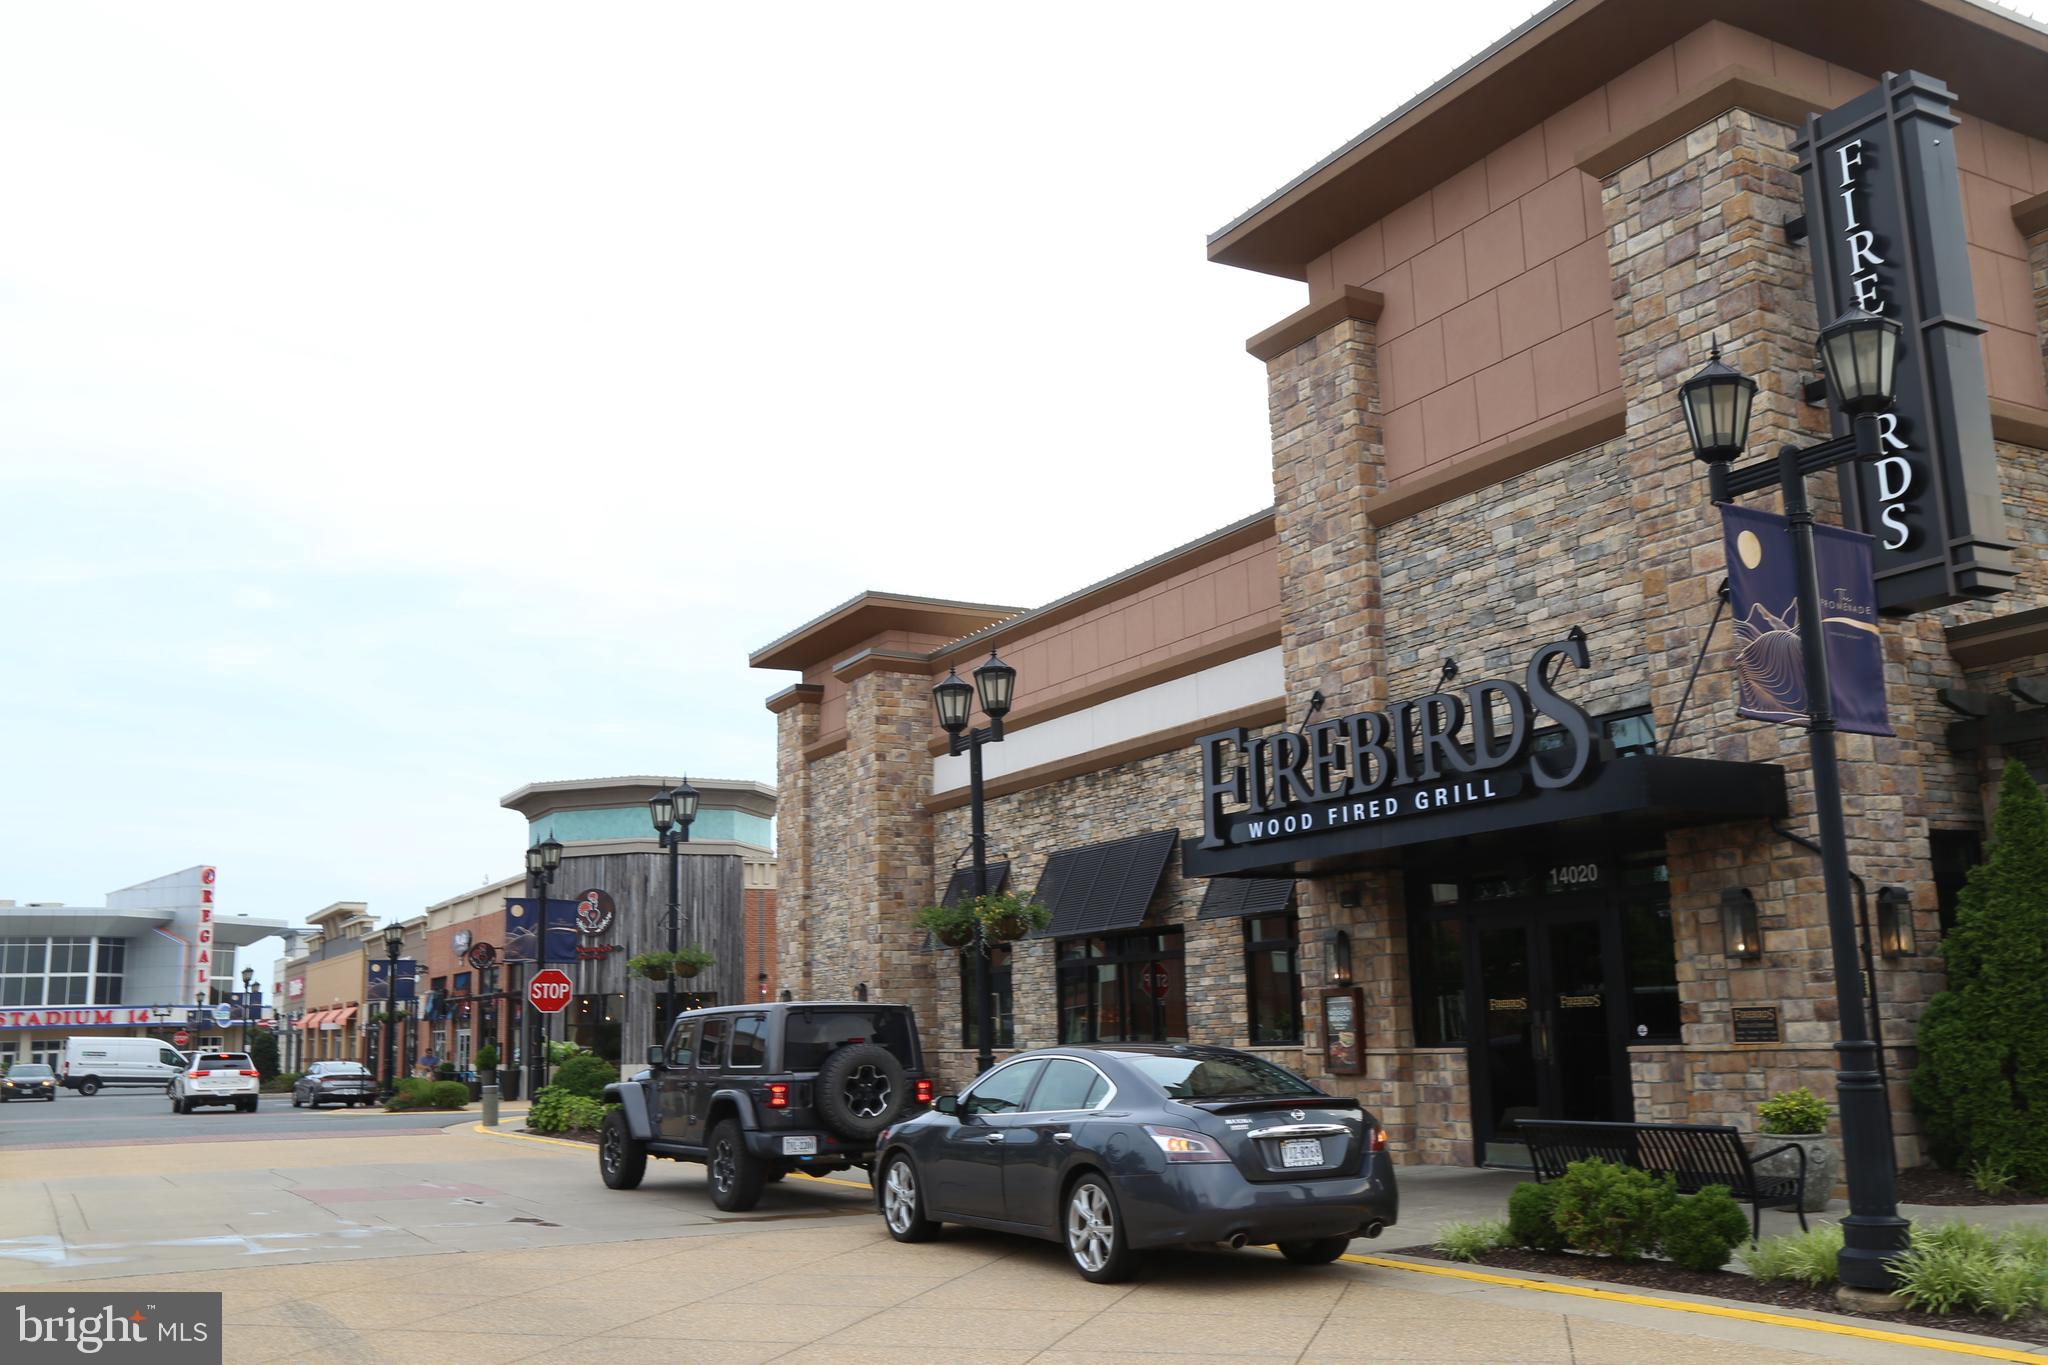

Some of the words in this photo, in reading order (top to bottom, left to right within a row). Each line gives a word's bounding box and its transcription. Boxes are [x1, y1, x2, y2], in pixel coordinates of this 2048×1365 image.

[1835, 139, 1912, 551] FIRERDS
[1820, 598, 1872, 615] PROEADE
[1195, 640, 1596, 849] FIREBIRDS
[1248, 813, 1313, 838] WOOD
[1328, 798, 1398, 825] FIRED
[1415, 779, 1496, 810] GRILL
[1549, 864, 1598, 885] 14020
[197, 889, 213, 983] REGAL
[531, 983, 570, 999] STOP
[128, 1009, 149, 1024] 14
